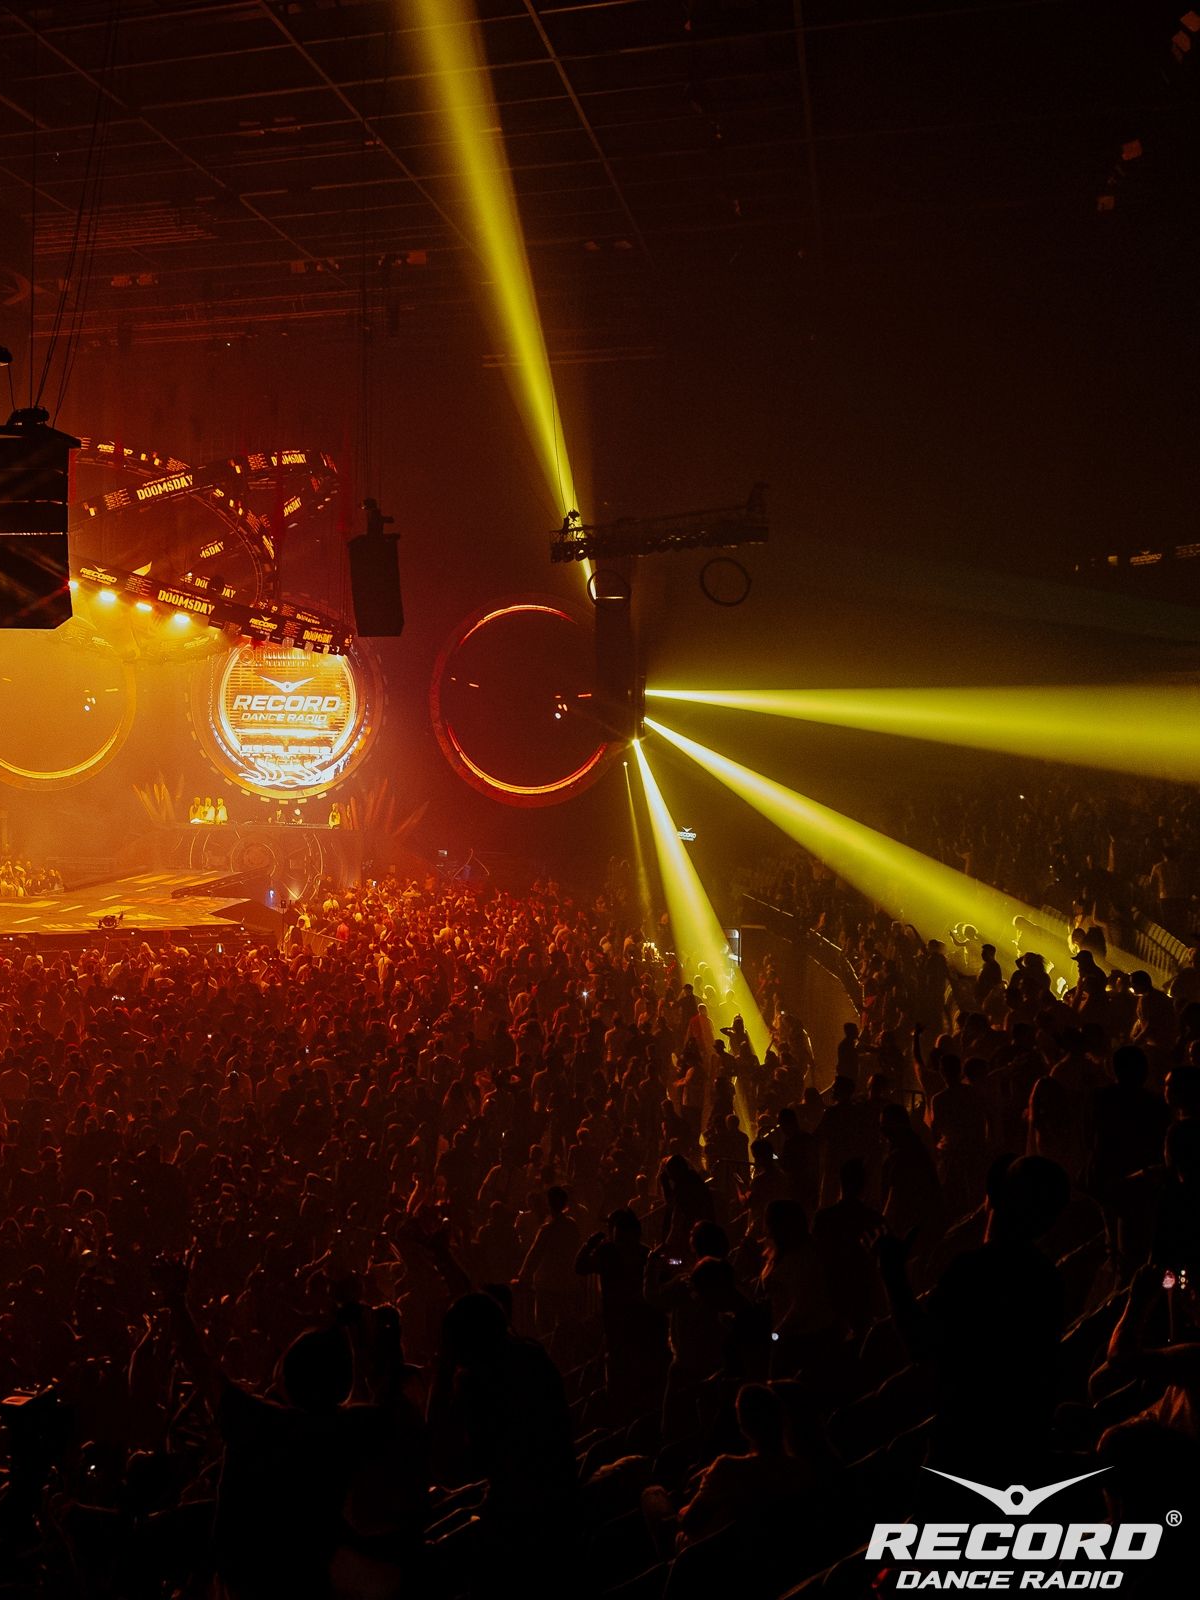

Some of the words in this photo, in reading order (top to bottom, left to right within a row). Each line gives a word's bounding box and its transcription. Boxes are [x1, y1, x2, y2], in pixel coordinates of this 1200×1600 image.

[136, 475, 193, 501] DOOMSDAY
[80, 567, 118, 583] RECORD
[157, 589, 216, 616] DOOMSDAY
[249, 617, 278, 630] RECORD
[232, 694, 341, 711] RECORD
[241, 712, 285, 722] DANCE
[287, 713, 328, 723] RADIO
